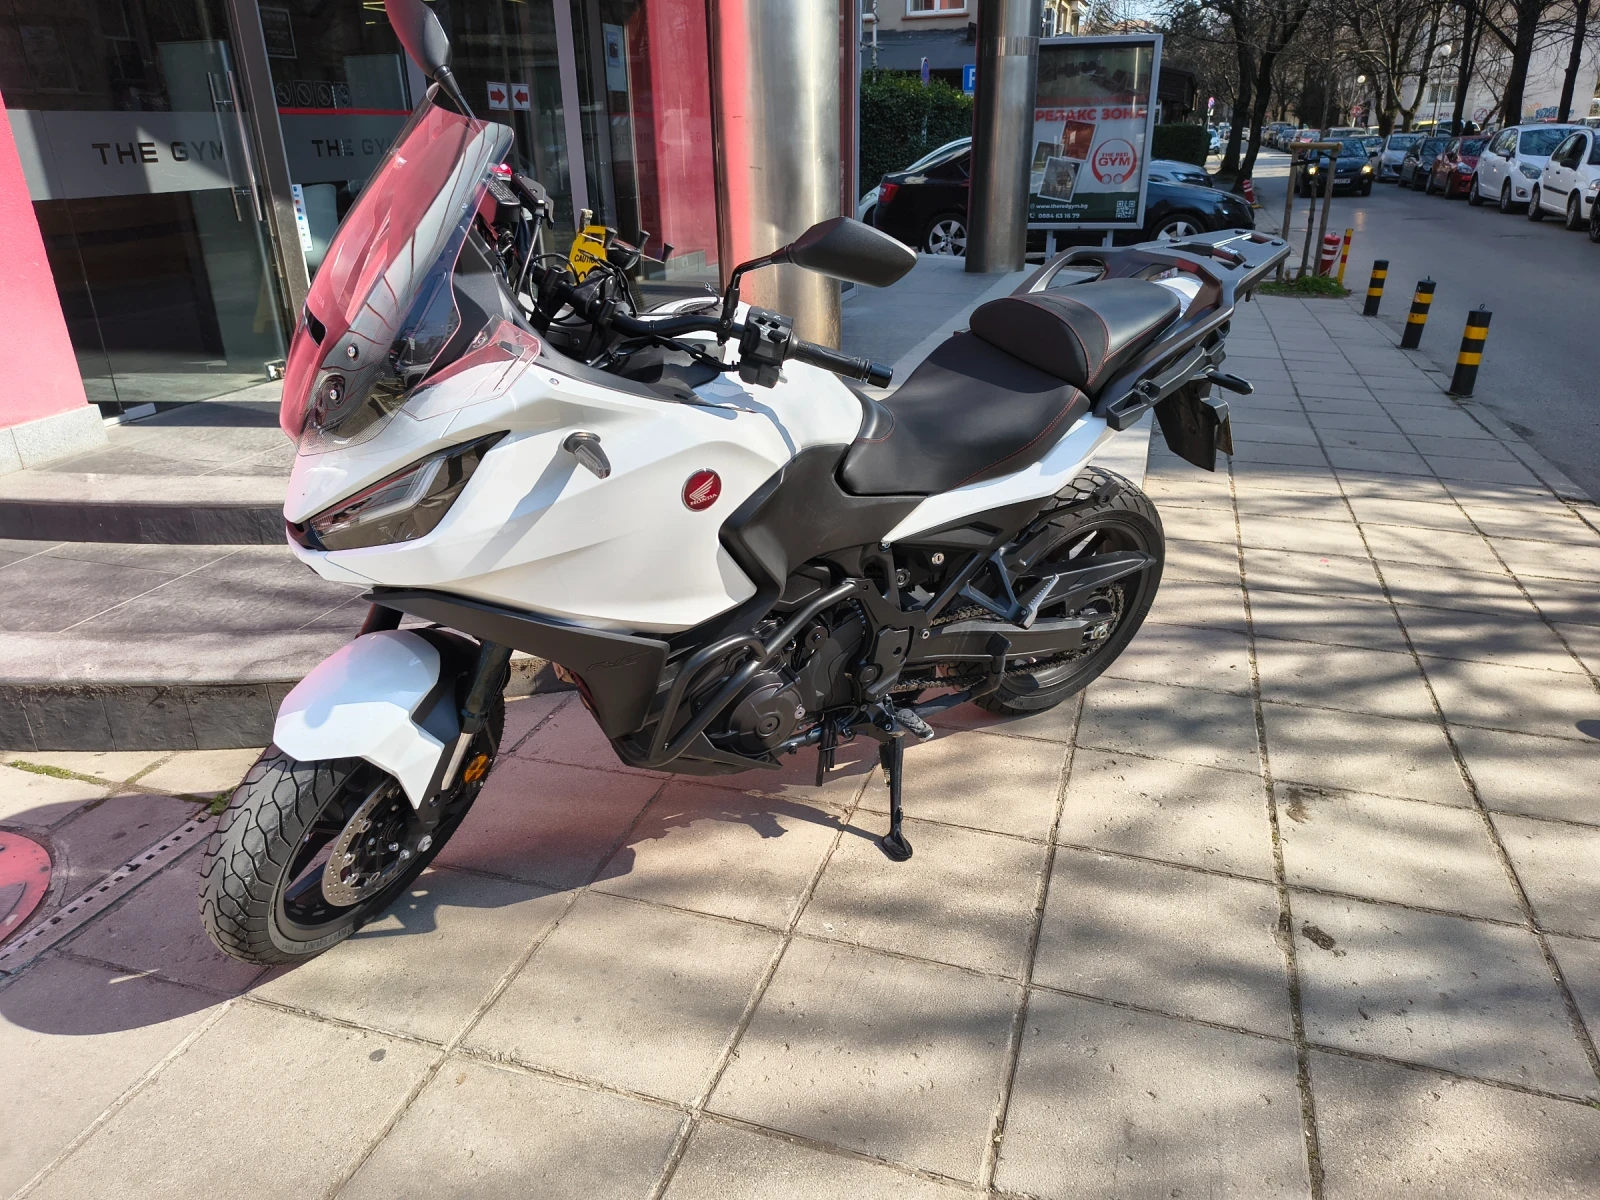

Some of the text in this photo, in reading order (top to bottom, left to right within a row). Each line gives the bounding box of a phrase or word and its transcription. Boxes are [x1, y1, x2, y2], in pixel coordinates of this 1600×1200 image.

[1035, 107, 1147, 121] РЕЛАКС ЗОНА
[91, 142, 159, 165] THE
[311, 138, 355, 158] THE
[1098, 157, 1130, 166] GYM
[690, 493, 717, 505] HONDA
